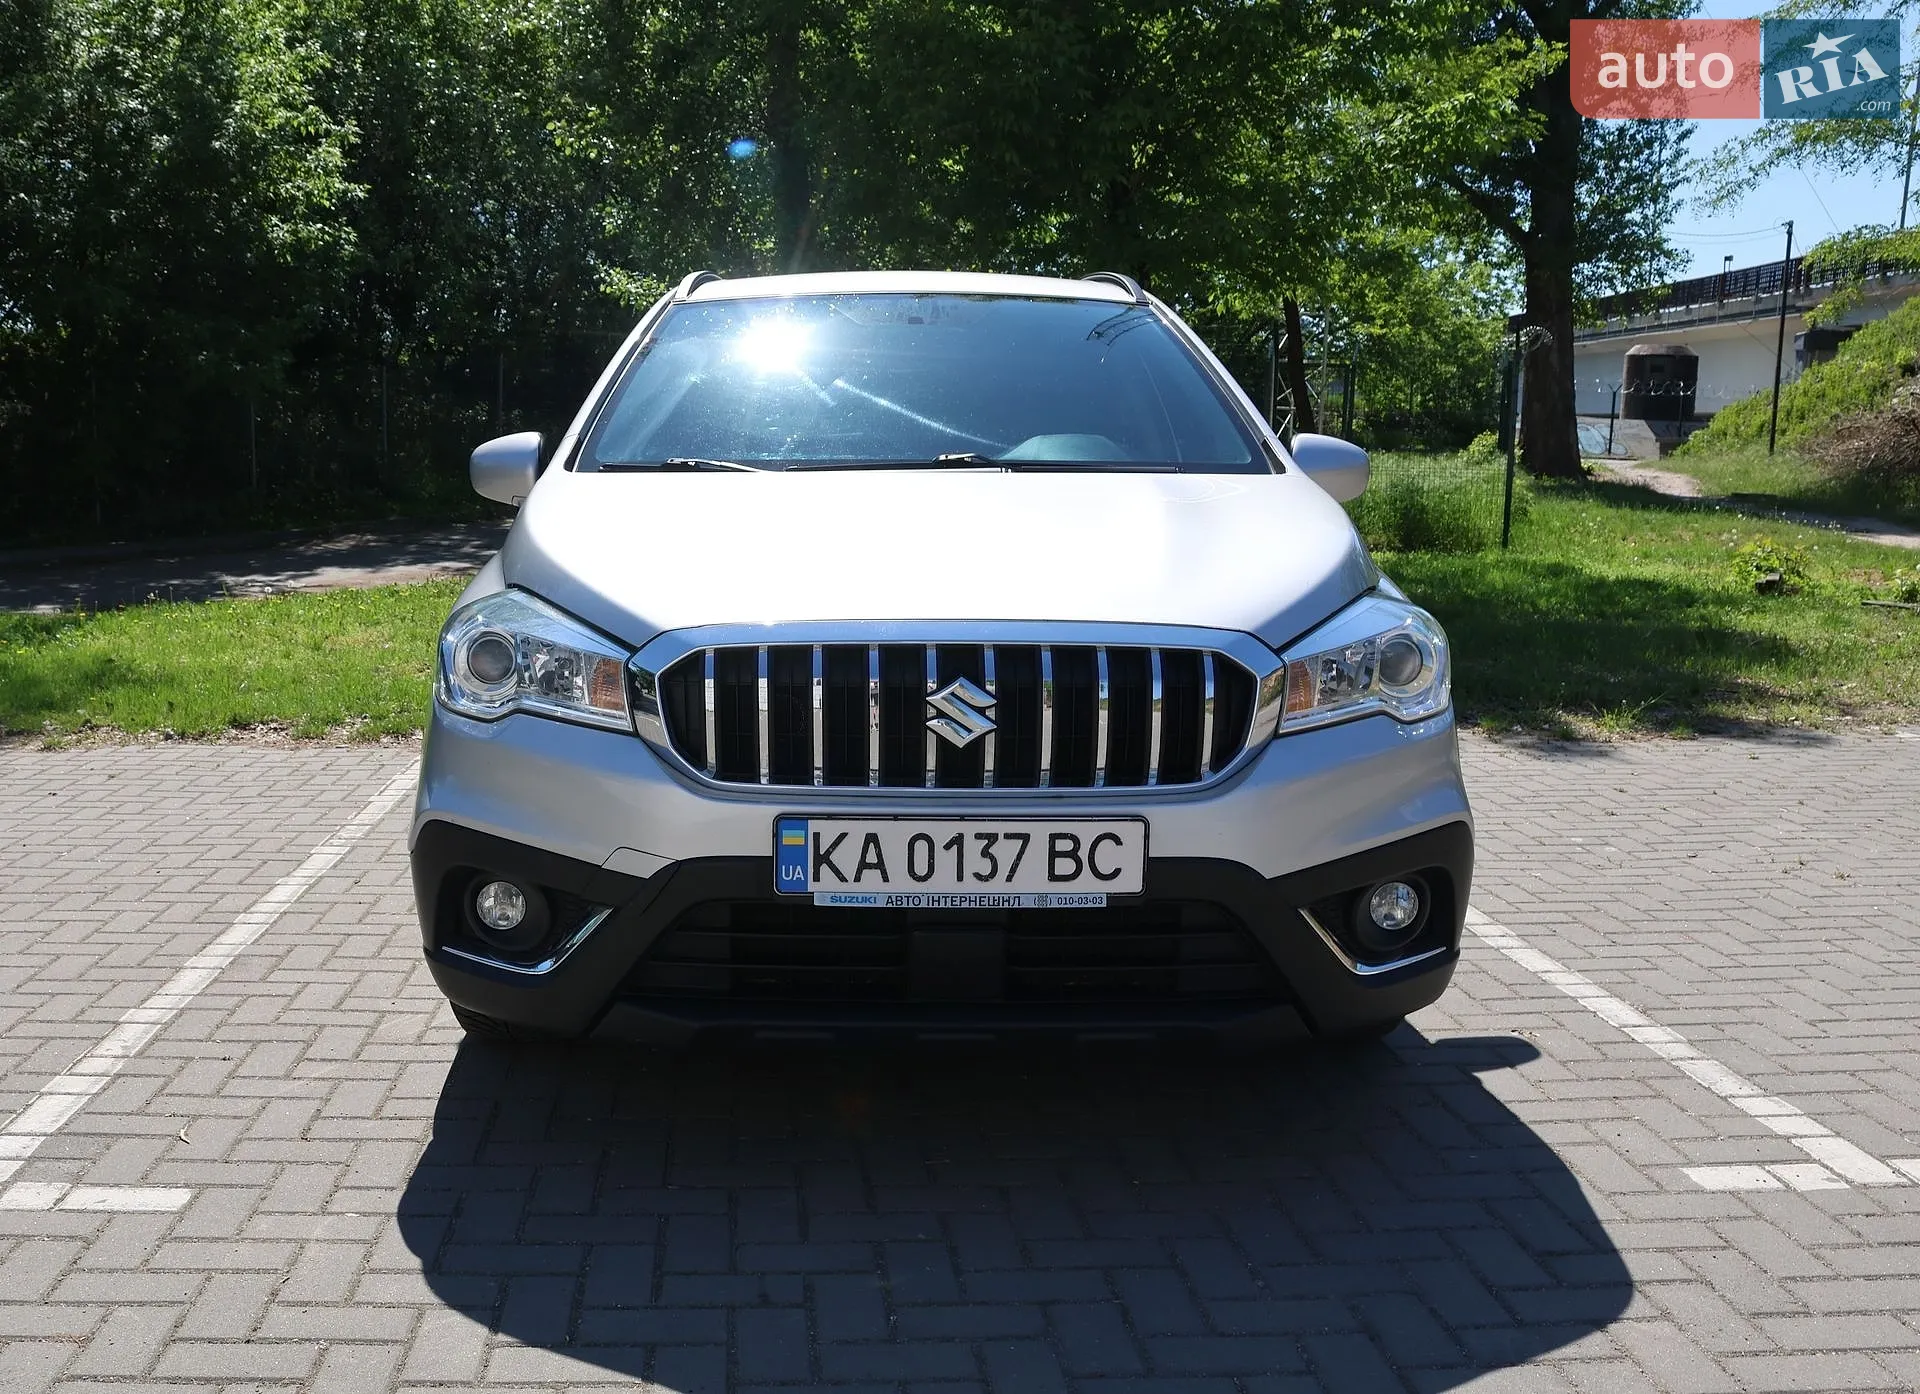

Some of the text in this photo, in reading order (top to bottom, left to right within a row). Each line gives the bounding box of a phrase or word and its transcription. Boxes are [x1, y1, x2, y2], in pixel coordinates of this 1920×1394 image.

[812, 832, 1123, 883] KA 0137 BC
[781, 865, 805, 881] UA
[830, 895, 877, 905] SUZUKI
[885, 895, 921, 907] АВТО
